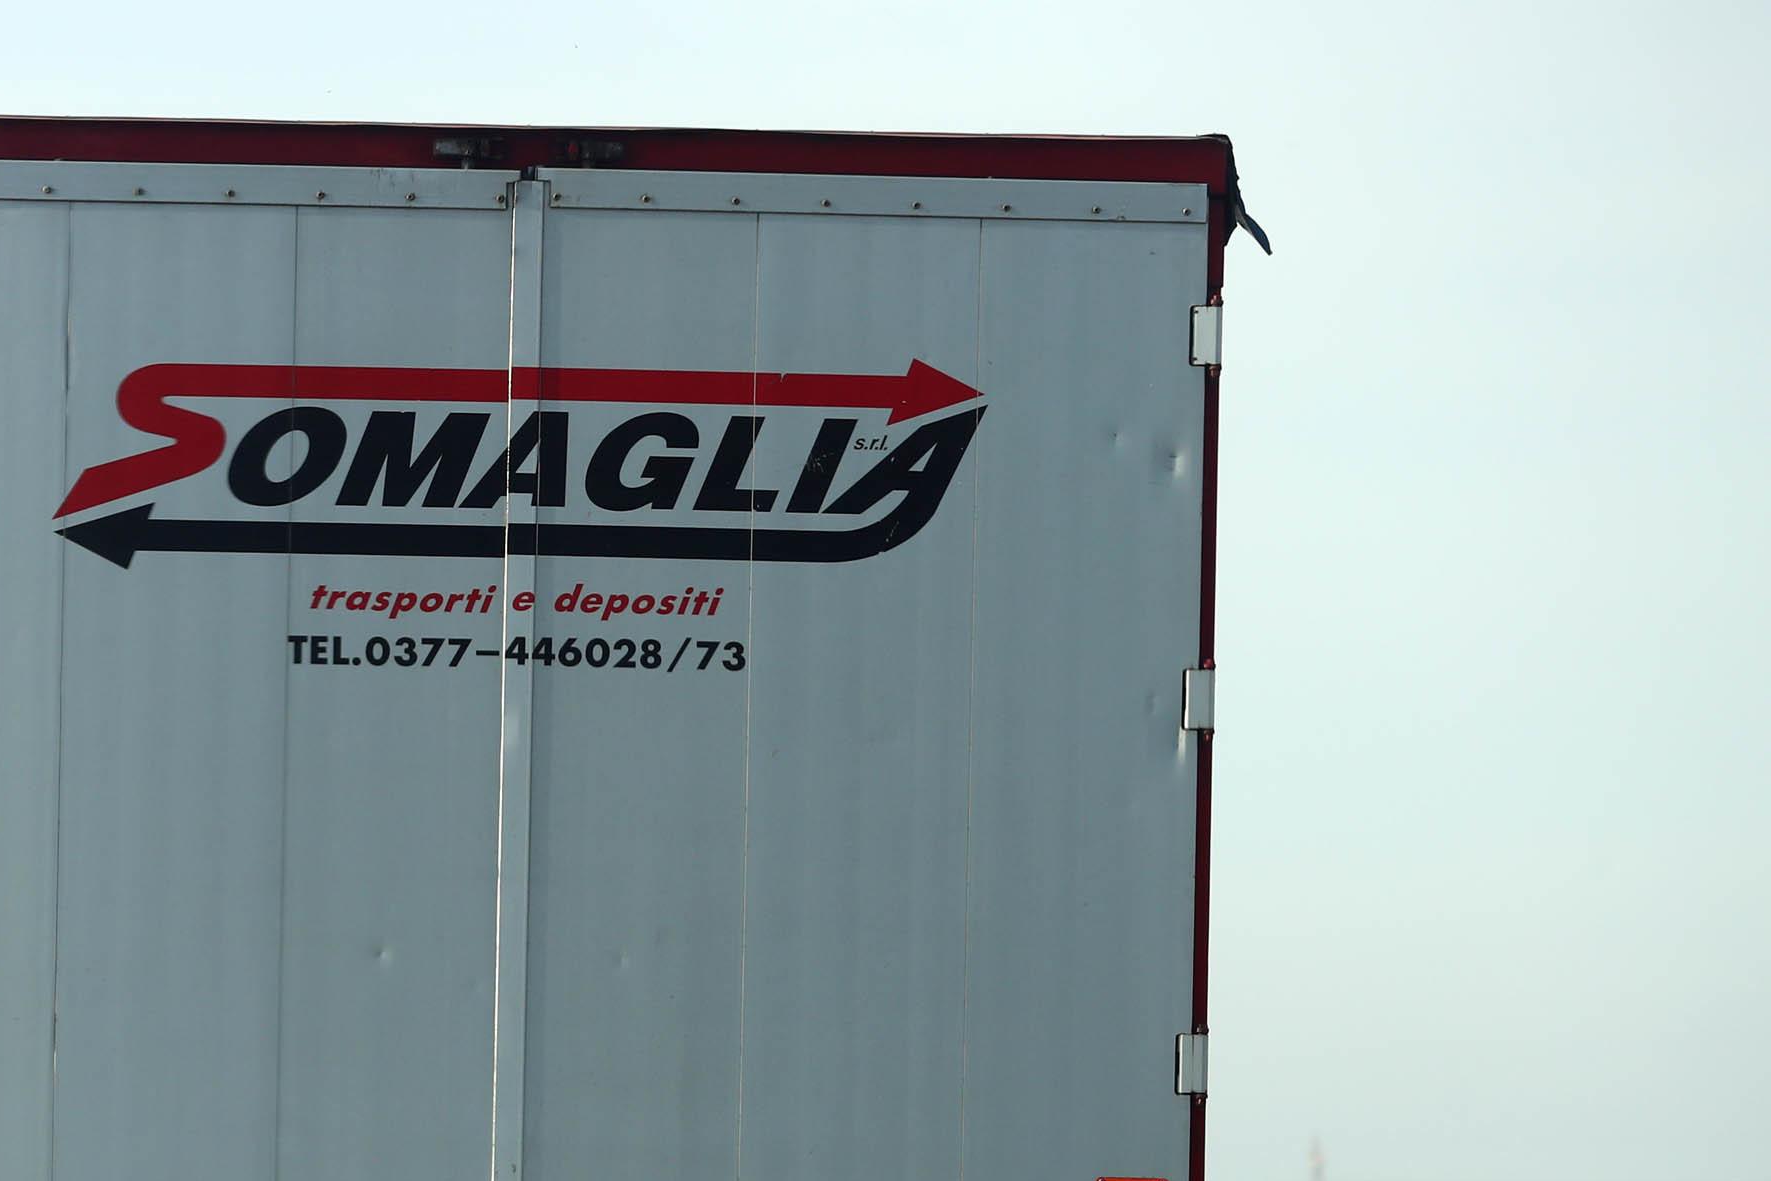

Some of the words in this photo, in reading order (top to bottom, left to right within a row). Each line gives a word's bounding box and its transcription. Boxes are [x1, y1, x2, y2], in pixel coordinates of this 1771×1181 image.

[53, 361, 987, 550] SOMAGLIA
[854, 433, 889, 453] s.r.l.
[310, 584, 496, 617] trasporti
[513, 590, 536, 613] e
[553, 584, 724, 621] depositi
